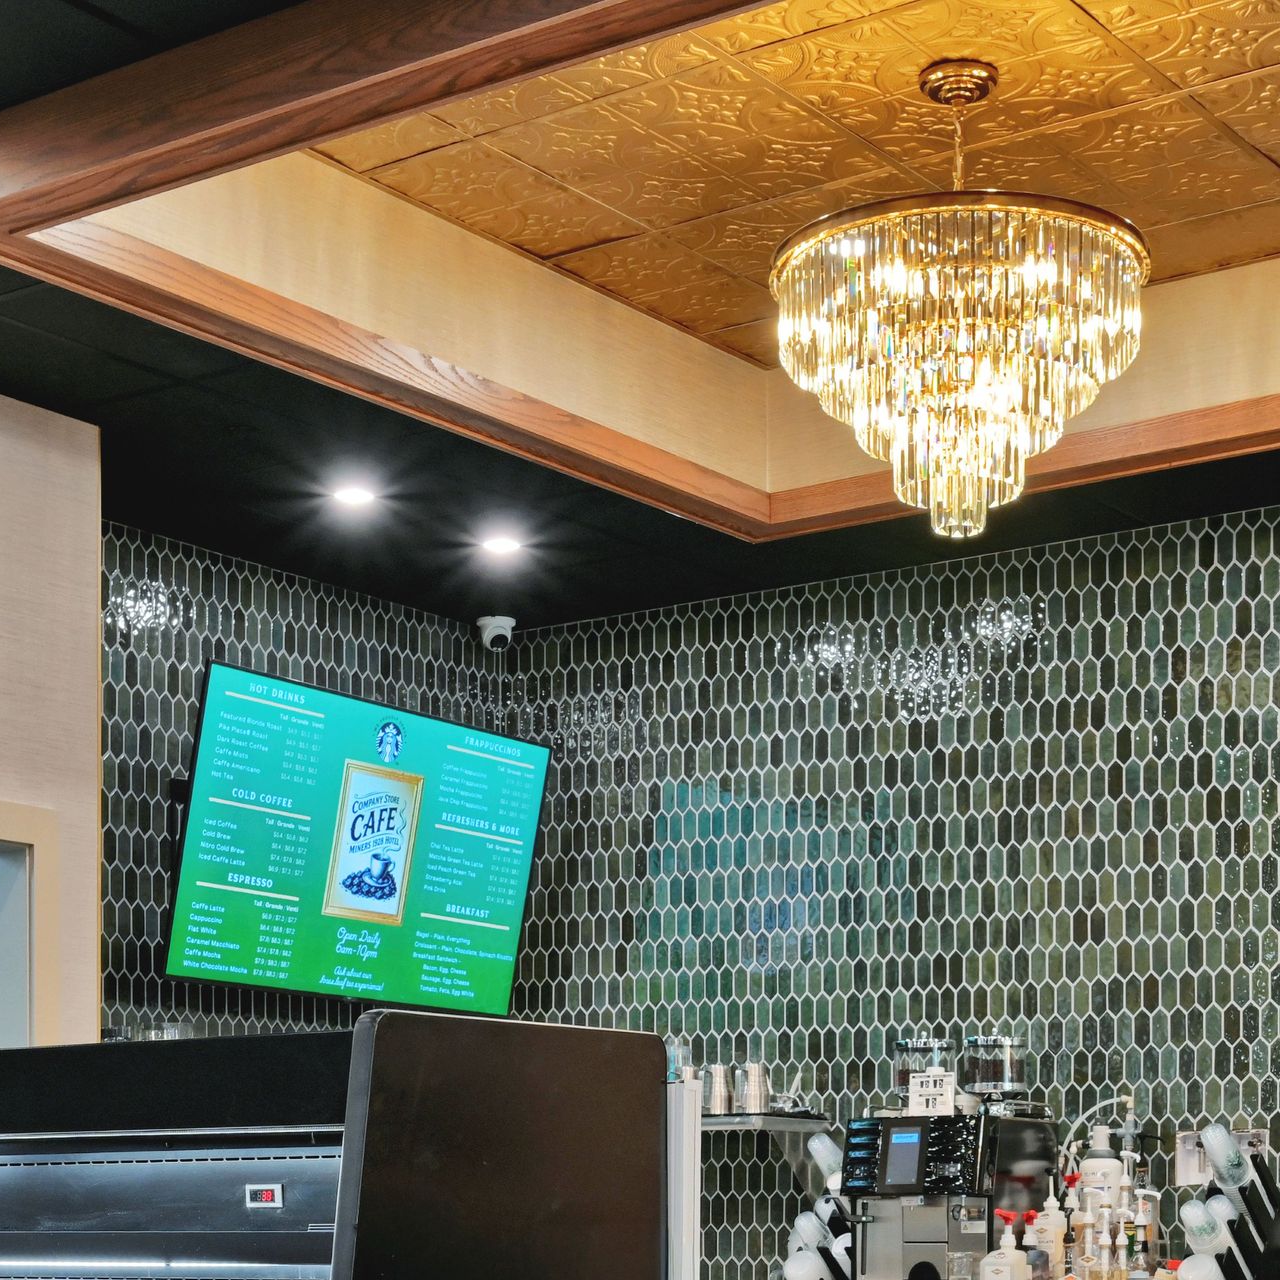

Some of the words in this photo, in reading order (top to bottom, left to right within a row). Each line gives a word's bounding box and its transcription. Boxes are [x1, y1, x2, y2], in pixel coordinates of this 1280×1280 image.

[249, 682, 268, 694] HOT
[271, 688, 305, 704] DRINKS
[464, 736, 521, 757] FRAPPUCCINOS
[231, 787, 256, 800] COLD
[259, 793, 293, 808] COFFEE
[352, 796, 383, 814] COMPANY
[350, 807, 398, 841] CAFE
[441, 811, 489, 829] REFRESHERS
[499, 823, 520, 835] MORE
[349, 840, 371, 854] MINERS
[384, 836, 399, 846] HOTEL
[227, 872, 273, 888] ESPRESSO
[446, 903, 490, 918] BREAKFAST
[200, 926, 216, 935] White
[337, 927, 357, 944] Open
[359, 930, 381, 949] Daily
[210, 940, 240, 950] Macchiato
[182, 959, 199, 968] White
[200, 962, 229, 971] Chocolate
